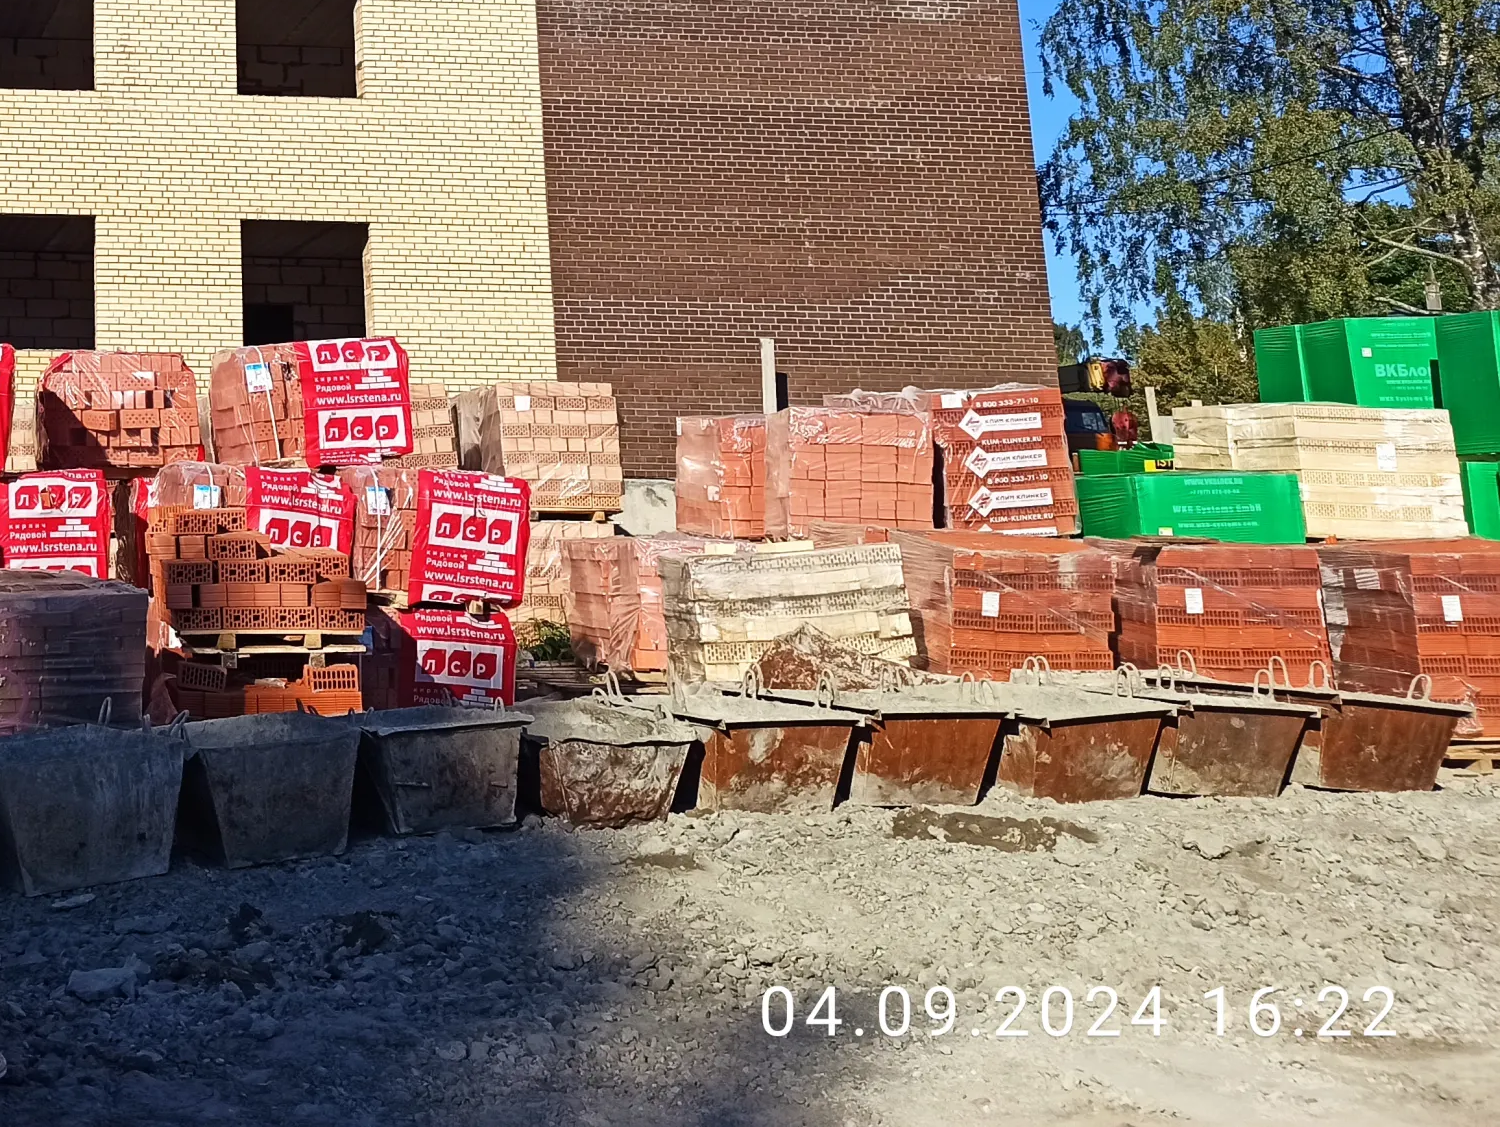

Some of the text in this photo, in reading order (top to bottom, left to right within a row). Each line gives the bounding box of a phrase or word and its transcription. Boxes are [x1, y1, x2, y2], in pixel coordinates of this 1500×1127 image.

[320, 349, 381, 362] ЛСР
[1374, 363, 1431, 378] ВКБло
[314, 375, 351, 383] кирпич
[315, 383, 352, 393] Рядовой
[316, 393, 402, 405] www.lsrstena.ru
[982, 400, 997, 408] 800
[998, 397, 1039, 406] 333-71-10
[327, 425, 389, 439] ЛСР
[981, 436, 1042, 446] KLIM-KLINKER.RU
[1010, 474, 1049, 482] 333-71-10
[433, 488, 522, 508] www.lsstena.ru
[990, 513, 1054, 523] KLIM-KLINKER.RU
[9, 531, 47, 541] Рядовой
[437, 521, 502, 542] ЛСР
[10, 541, 98, 554] www.lsrstena.ru
[425, 557, 465, 570] Рядовой
[424, 570, 514, 590] www.lsrstena.ru
[414, 612, 453, 624] Рядовой
[424, 659, 486, 676] ЛСР
